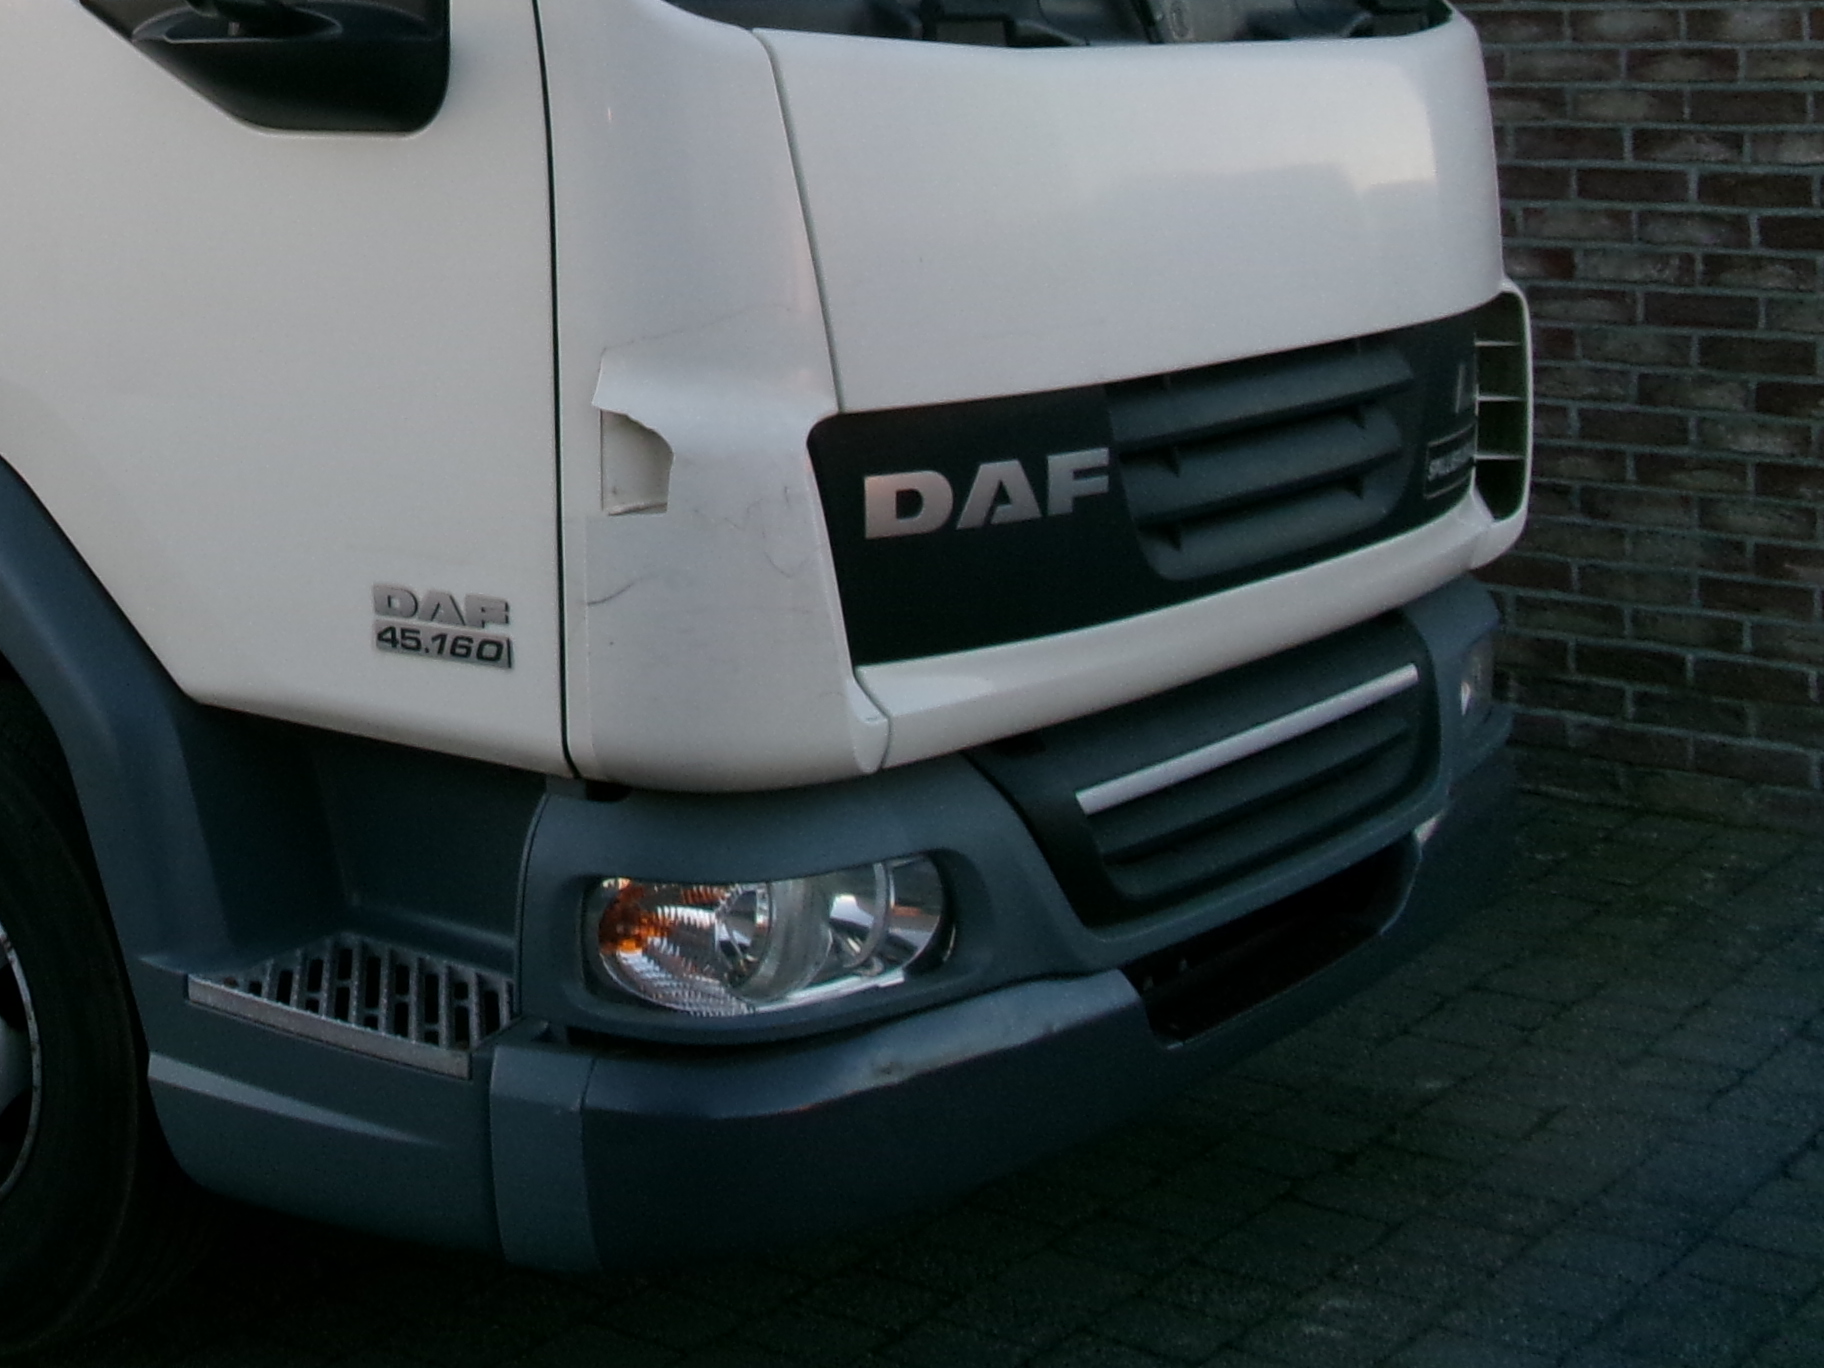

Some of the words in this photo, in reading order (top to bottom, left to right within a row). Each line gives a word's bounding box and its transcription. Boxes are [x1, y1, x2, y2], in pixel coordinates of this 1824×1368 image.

[863, 446, 1110, 540] DAF
[373, 583, 510, 629] DAF
[376, 625, 504, 662] 45.160
